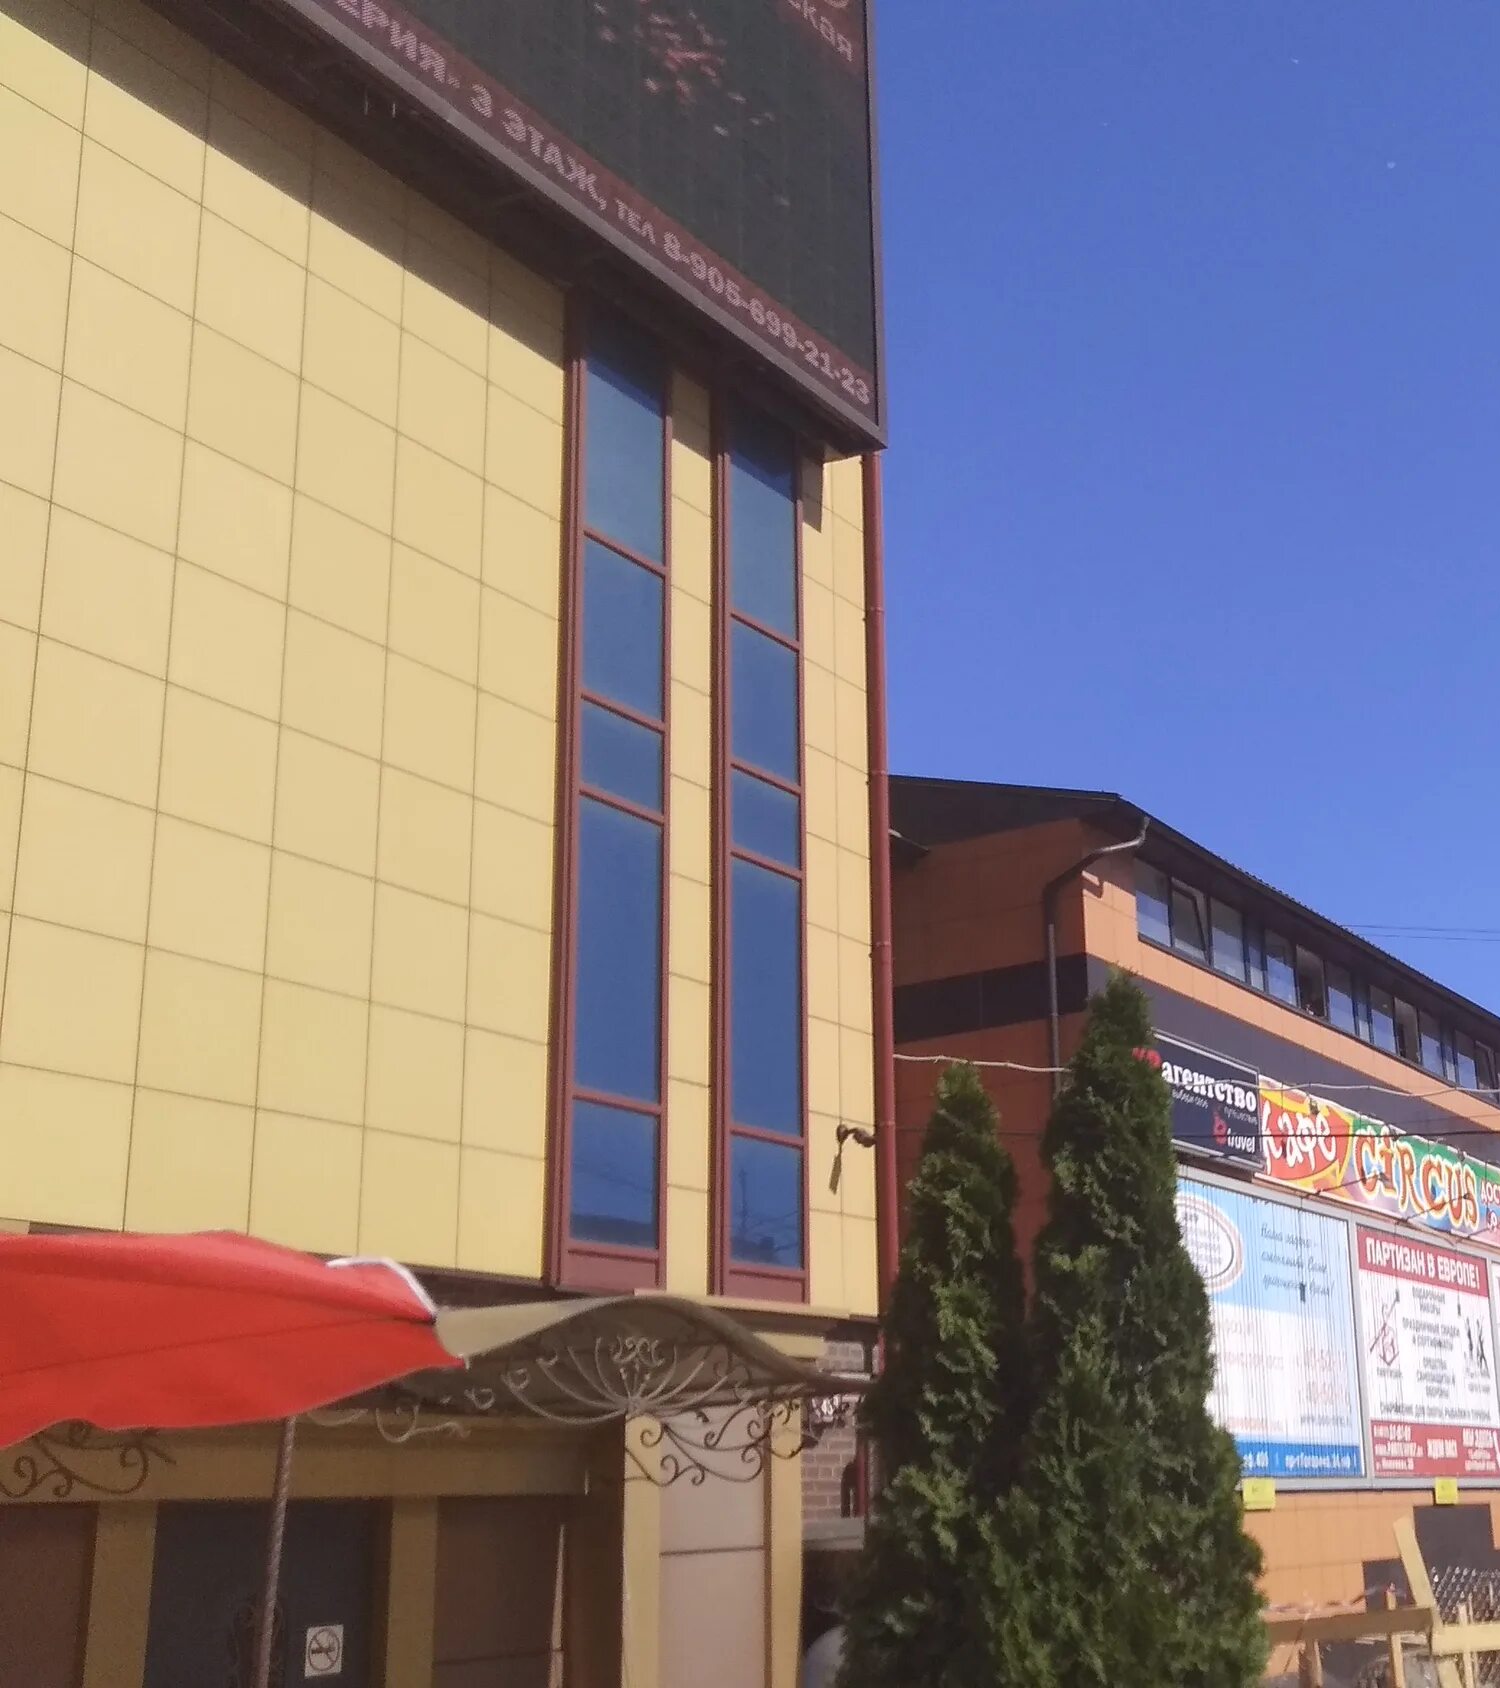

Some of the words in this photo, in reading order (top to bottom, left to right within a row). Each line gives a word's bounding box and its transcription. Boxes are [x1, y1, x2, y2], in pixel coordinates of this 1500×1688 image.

[470, 84, 493, 118] 3
[1161, 1061, 1257, 1112] агентство
[1366, 1237, 1425, 1276] ПАРТИЗАН
[1427, 1253, 1435, 1278] В
[1437, 1255, 1480, 1289] ЕВРОПЕ!
